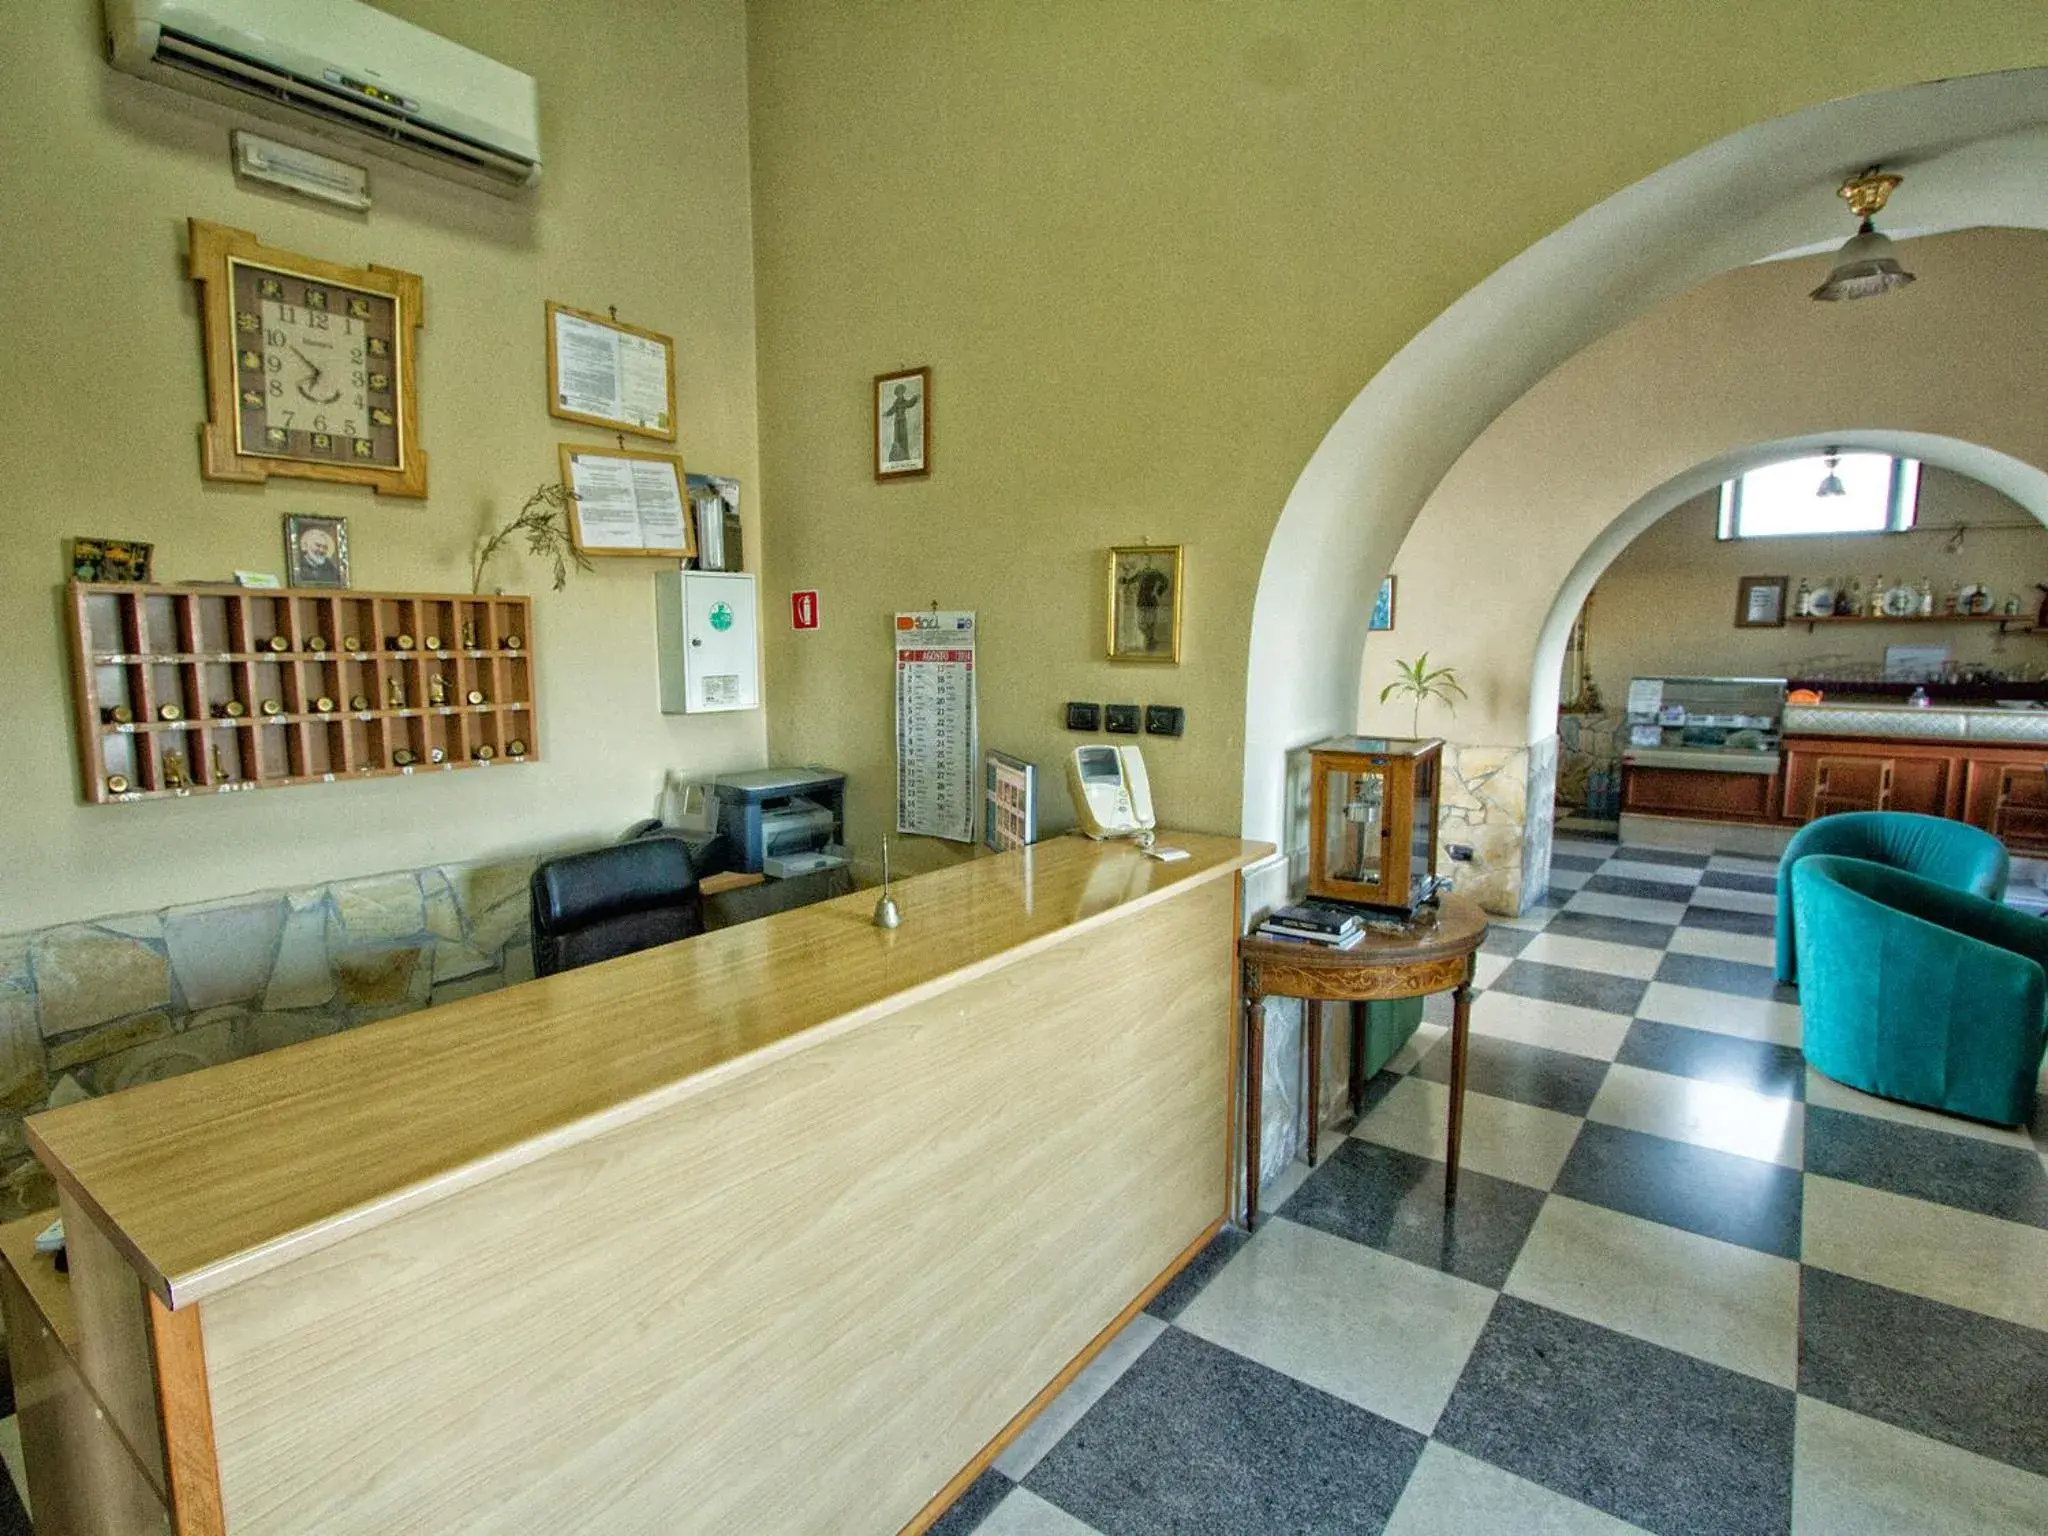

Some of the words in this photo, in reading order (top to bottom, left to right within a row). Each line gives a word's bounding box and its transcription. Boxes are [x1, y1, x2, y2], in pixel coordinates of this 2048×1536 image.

[279, 305, 297, 325] 11
[308, 312, 329, 331] 12
[343, 319, 353, 335] 1
[266, 328, 287, 348] 10
[266, 356, 283, 373] 9
[350, 348, 363, 365] 2
[269, 379, 284, 398] 8
[351, 371, 365, 388] 3
[282, 410, 296, 428] 7
[313, 414, 328, 432] 6
[342, 419, 357, 436] 5
